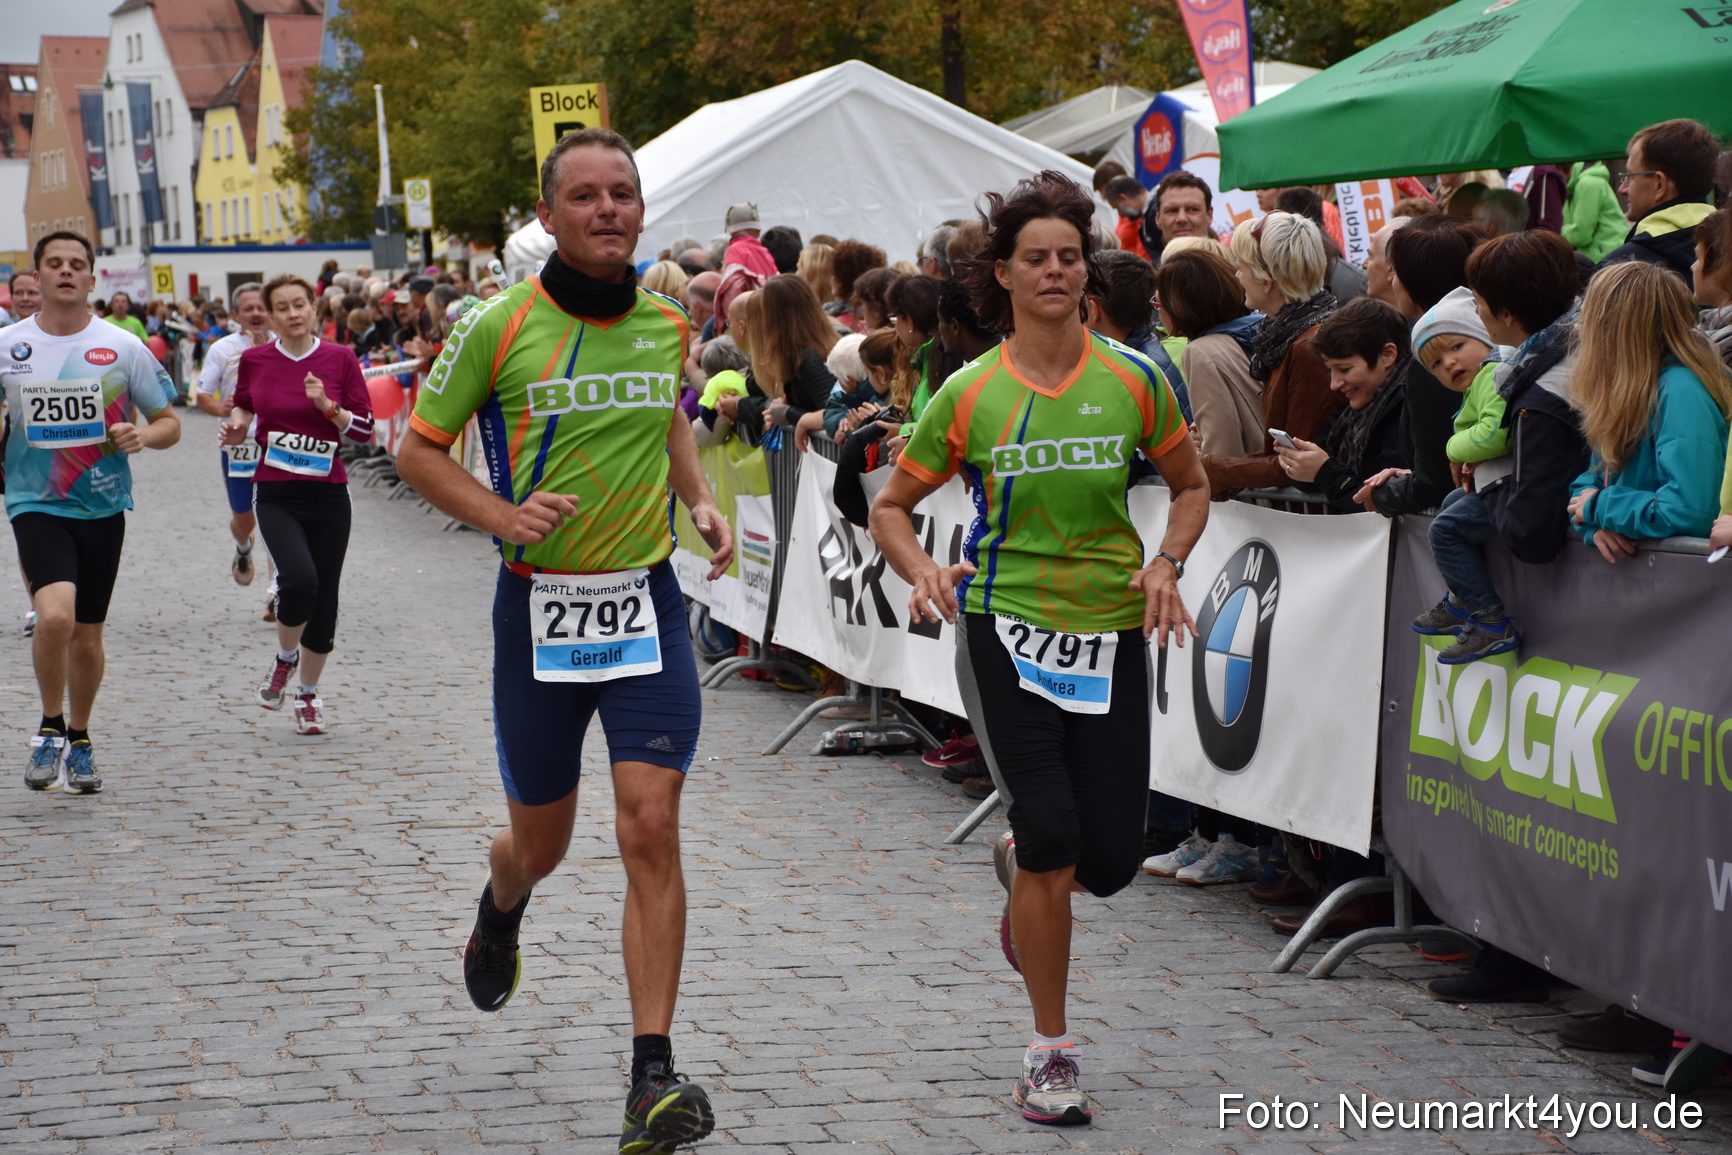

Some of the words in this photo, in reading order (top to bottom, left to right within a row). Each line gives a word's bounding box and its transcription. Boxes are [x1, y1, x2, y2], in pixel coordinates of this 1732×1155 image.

[540, 89, 599, 112] Block
[31, 396, 97, 422] 2505
[527, 372, 676, 417] BOCK
[42, 427, 89, 439] Christian
[992, 435, 1125, 477] BOCK
[534, 585, 573, 596] PARTL
[576, 582, 632, 596] Neumarkt
[1211, 547, 1278, 623] BMW
[543, 596, 646, 639] 2792
[571, 647, 623, 666] Gerald
[1008, 624, 1103, 671] 2791
[1036, 671, 1076, 696] Andrea
[1418, 644, 1620, 800] BOCK
[1406, 763, 1470, 818] inspired
[1471, 796, 1483, 837] by
[1486, 803, 1533, 849] smart
[1535, 823, 1619, 881] concepts
